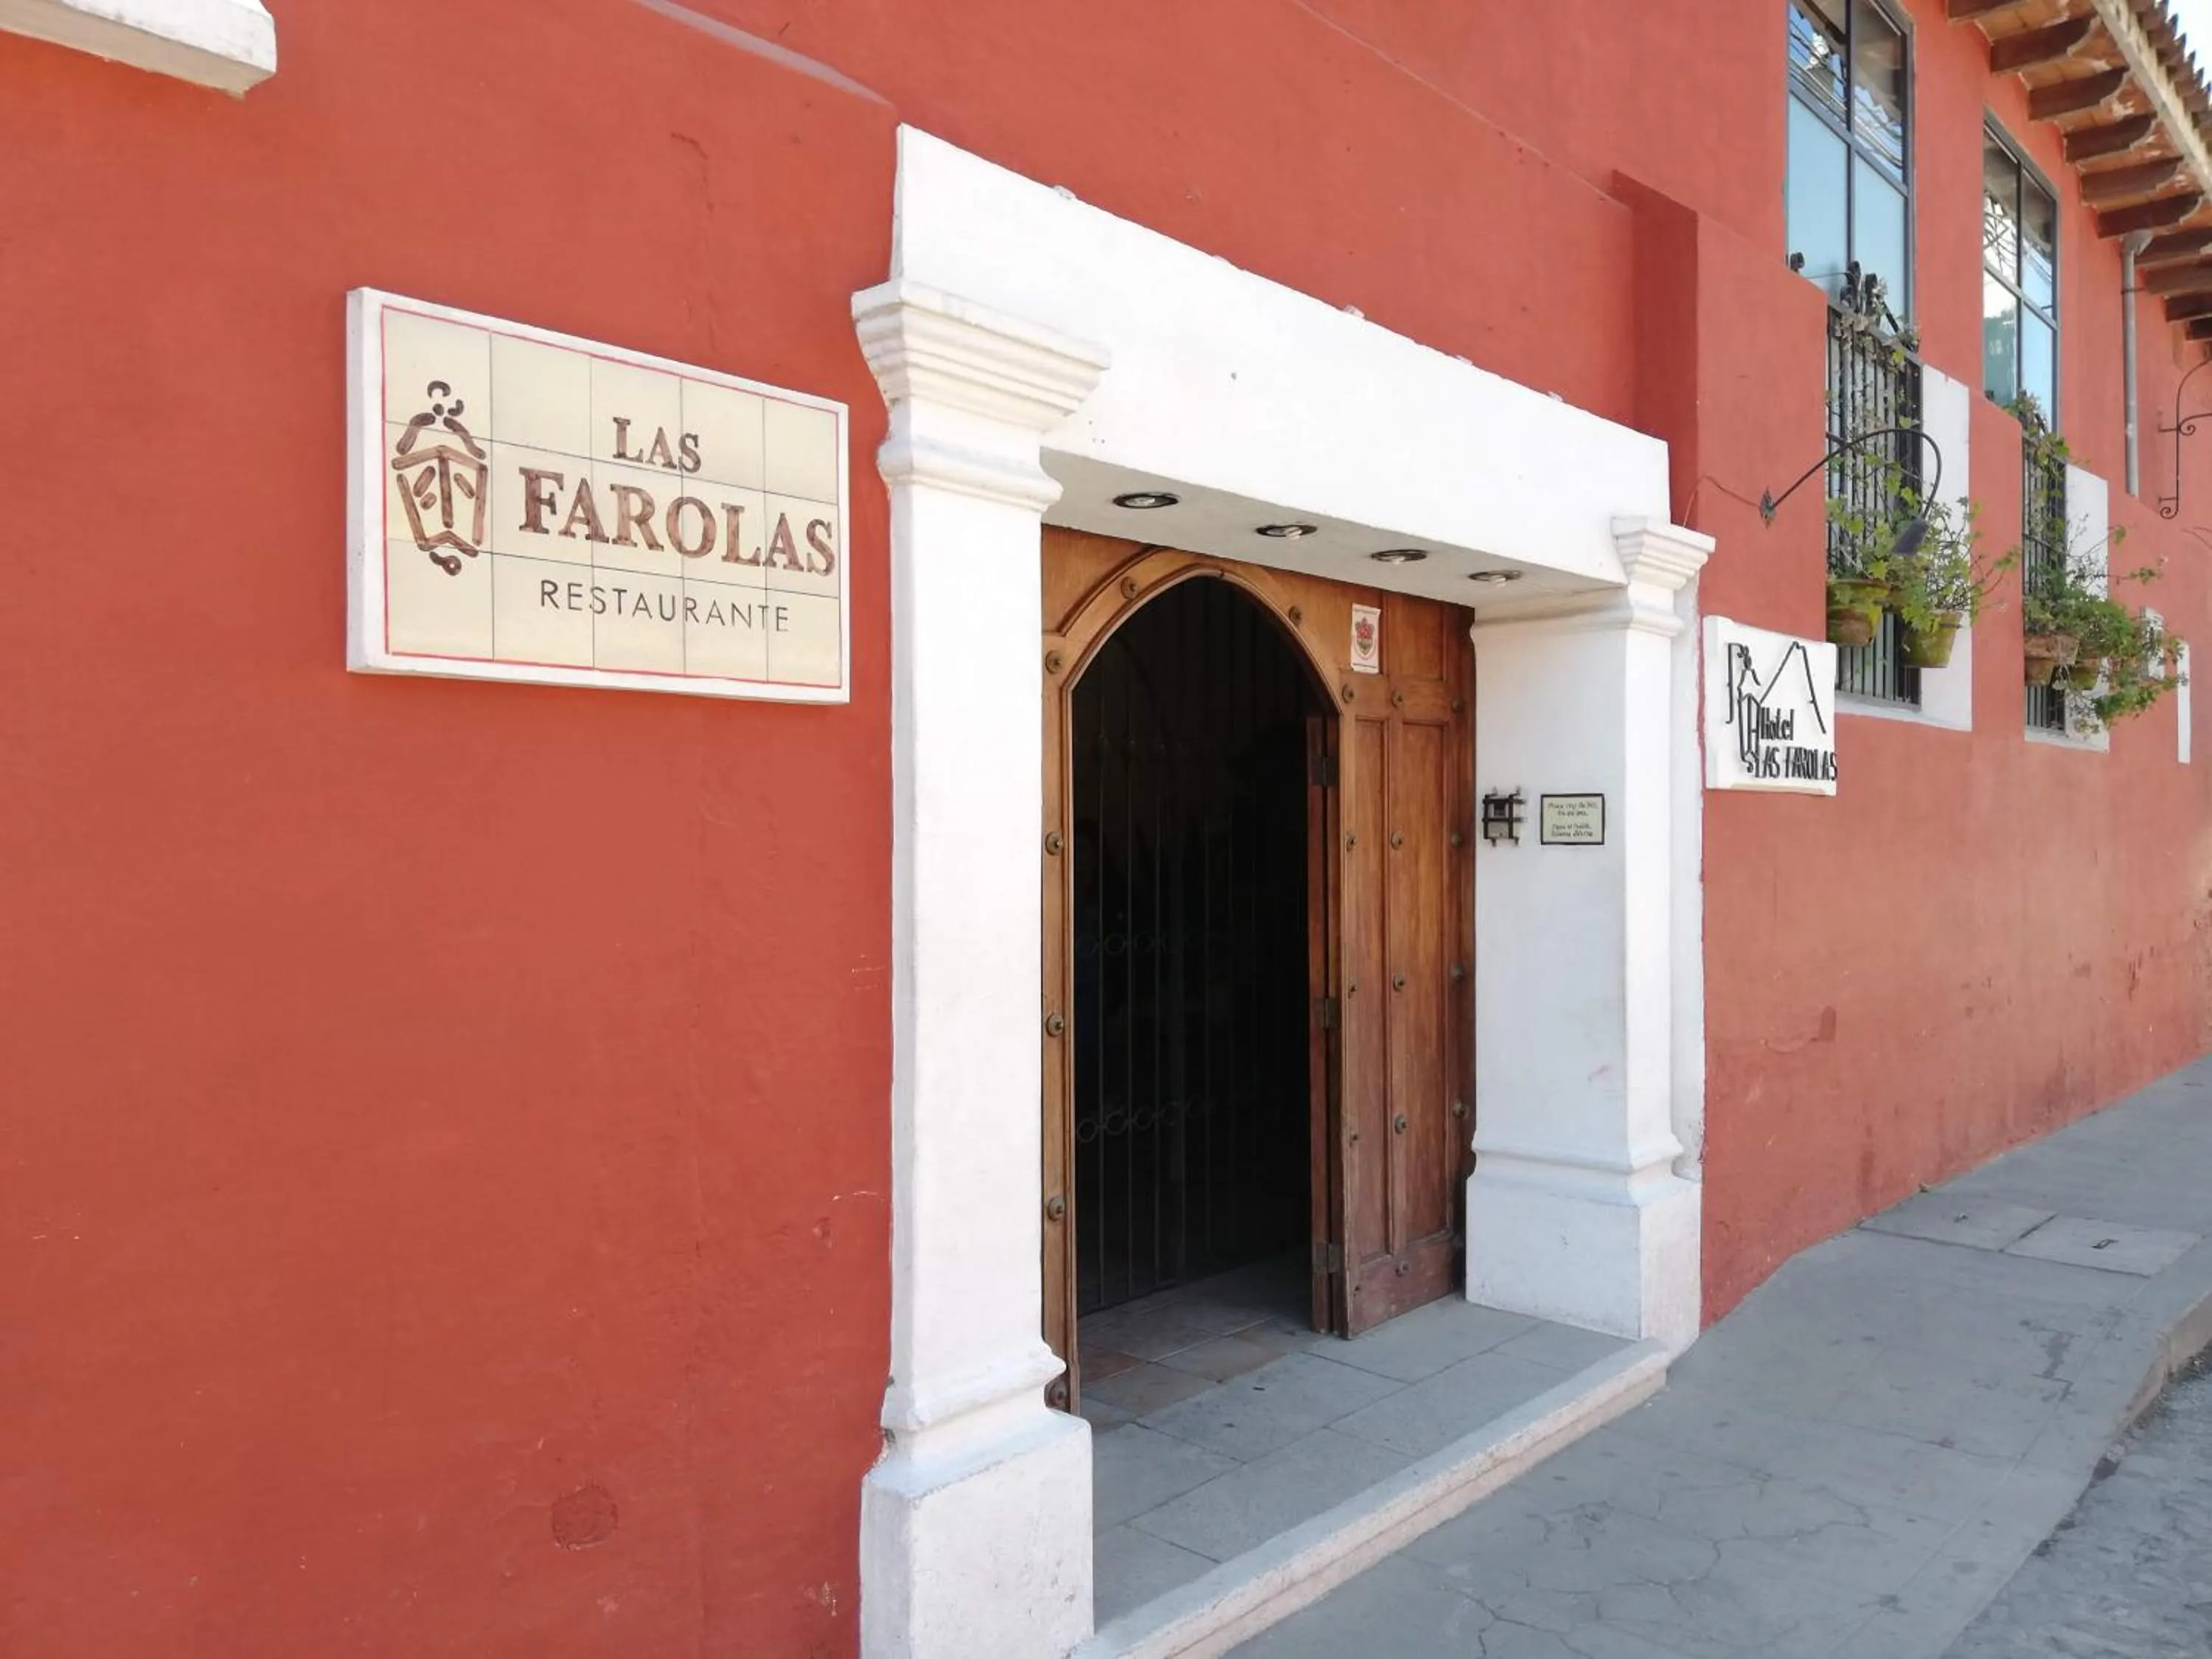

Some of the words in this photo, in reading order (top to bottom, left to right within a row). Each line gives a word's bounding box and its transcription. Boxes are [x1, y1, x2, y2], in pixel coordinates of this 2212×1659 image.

[613, 417, 700, 473] LAS
[519, 467, 836, 577] FAROLAS
[541, 580, 789, 632] RESTAURANTE
[1761, 707, 1794, 740] Hotel
[1756, 745, 1781, 779] LAS
[1784, 746, 1838, 780] FAROLAS
